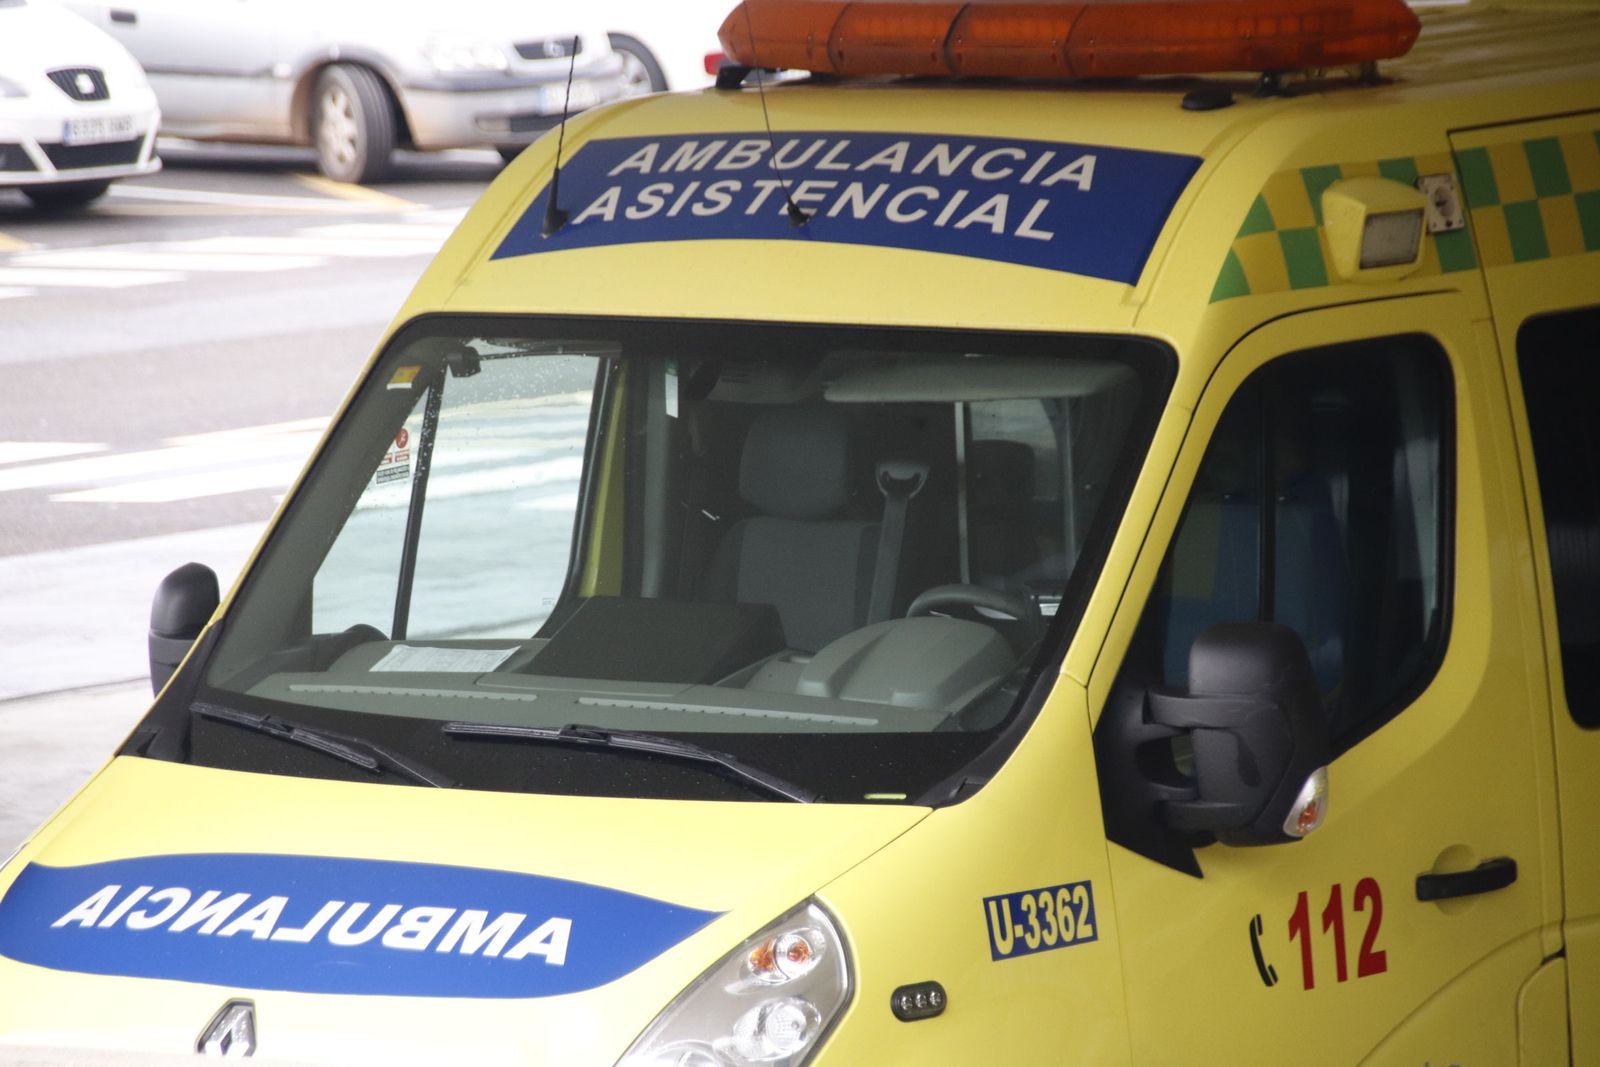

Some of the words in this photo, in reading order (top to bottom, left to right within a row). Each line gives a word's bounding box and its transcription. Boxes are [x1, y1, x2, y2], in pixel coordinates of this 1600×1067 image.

[607, 138, 1099, 192] AMBULANCIA
[572, 179, 1056, 242] ASISTENCIAL
[988, 883, 1095, 957] U-3362
[1288, 876, 1388, 991] 112
